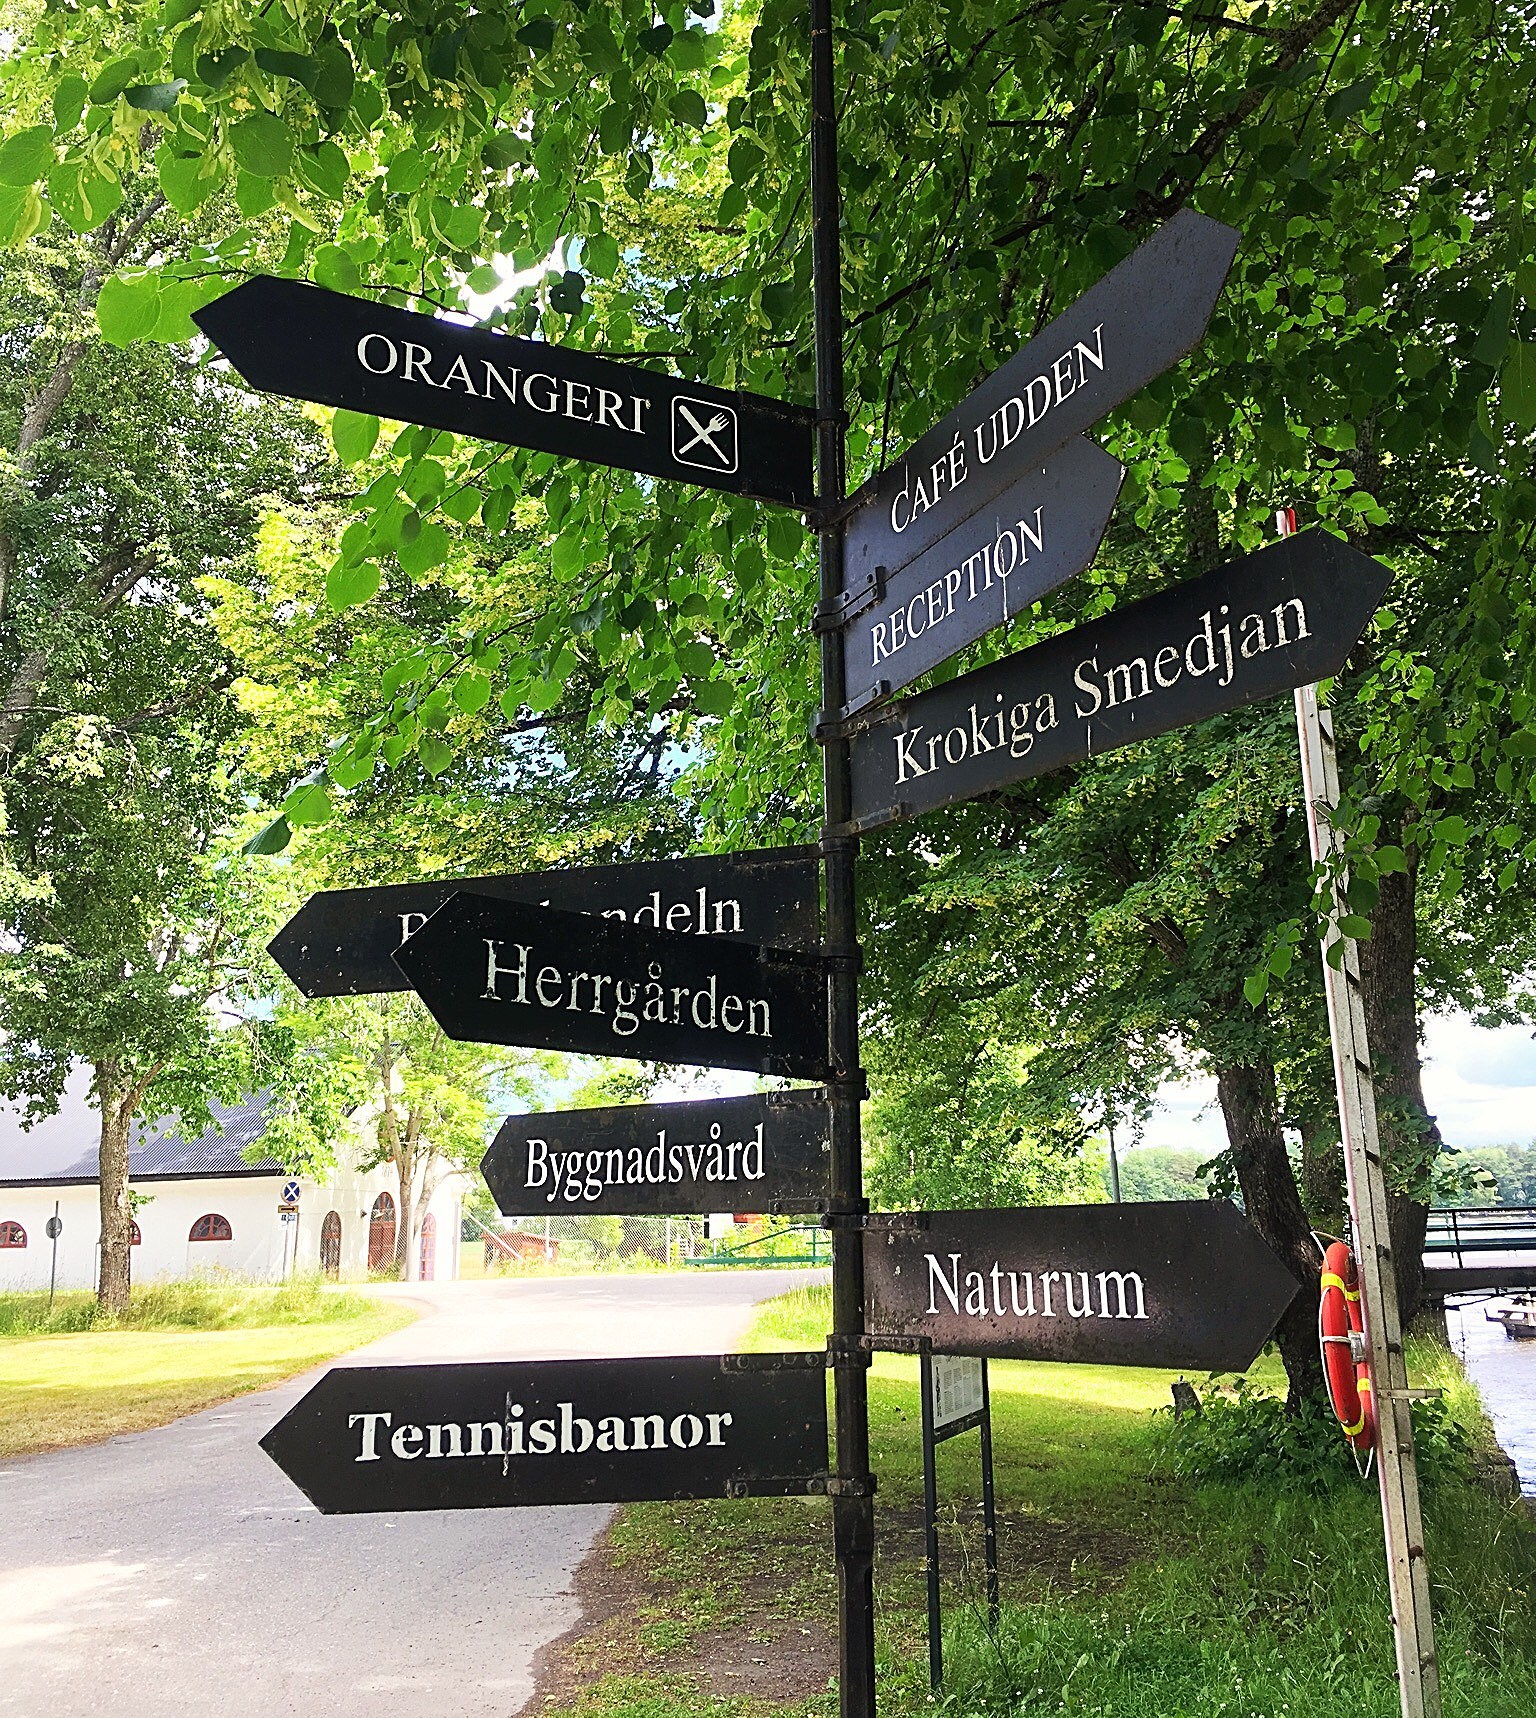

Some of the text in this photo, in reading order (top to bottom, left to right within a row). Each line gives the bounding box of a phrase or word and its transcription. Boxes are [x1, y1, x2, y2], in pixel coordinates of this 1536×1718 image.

[357, 333, 646, 435] ORANGERI
[889, 323, 1105, 533] CAFÉ UDDEN
[871, 506, 1047, 667] RECEPTION
[893, 597, 1313, 785] Krokiga Smedjan
[479, 938, 774, 1038] Herrgården
[524, 1121, 766, 1203] Byggnadsvård
[923, 1253, 1150, 1319] Naturum
[348, 1403, 733, 1462] Tennisbanor
